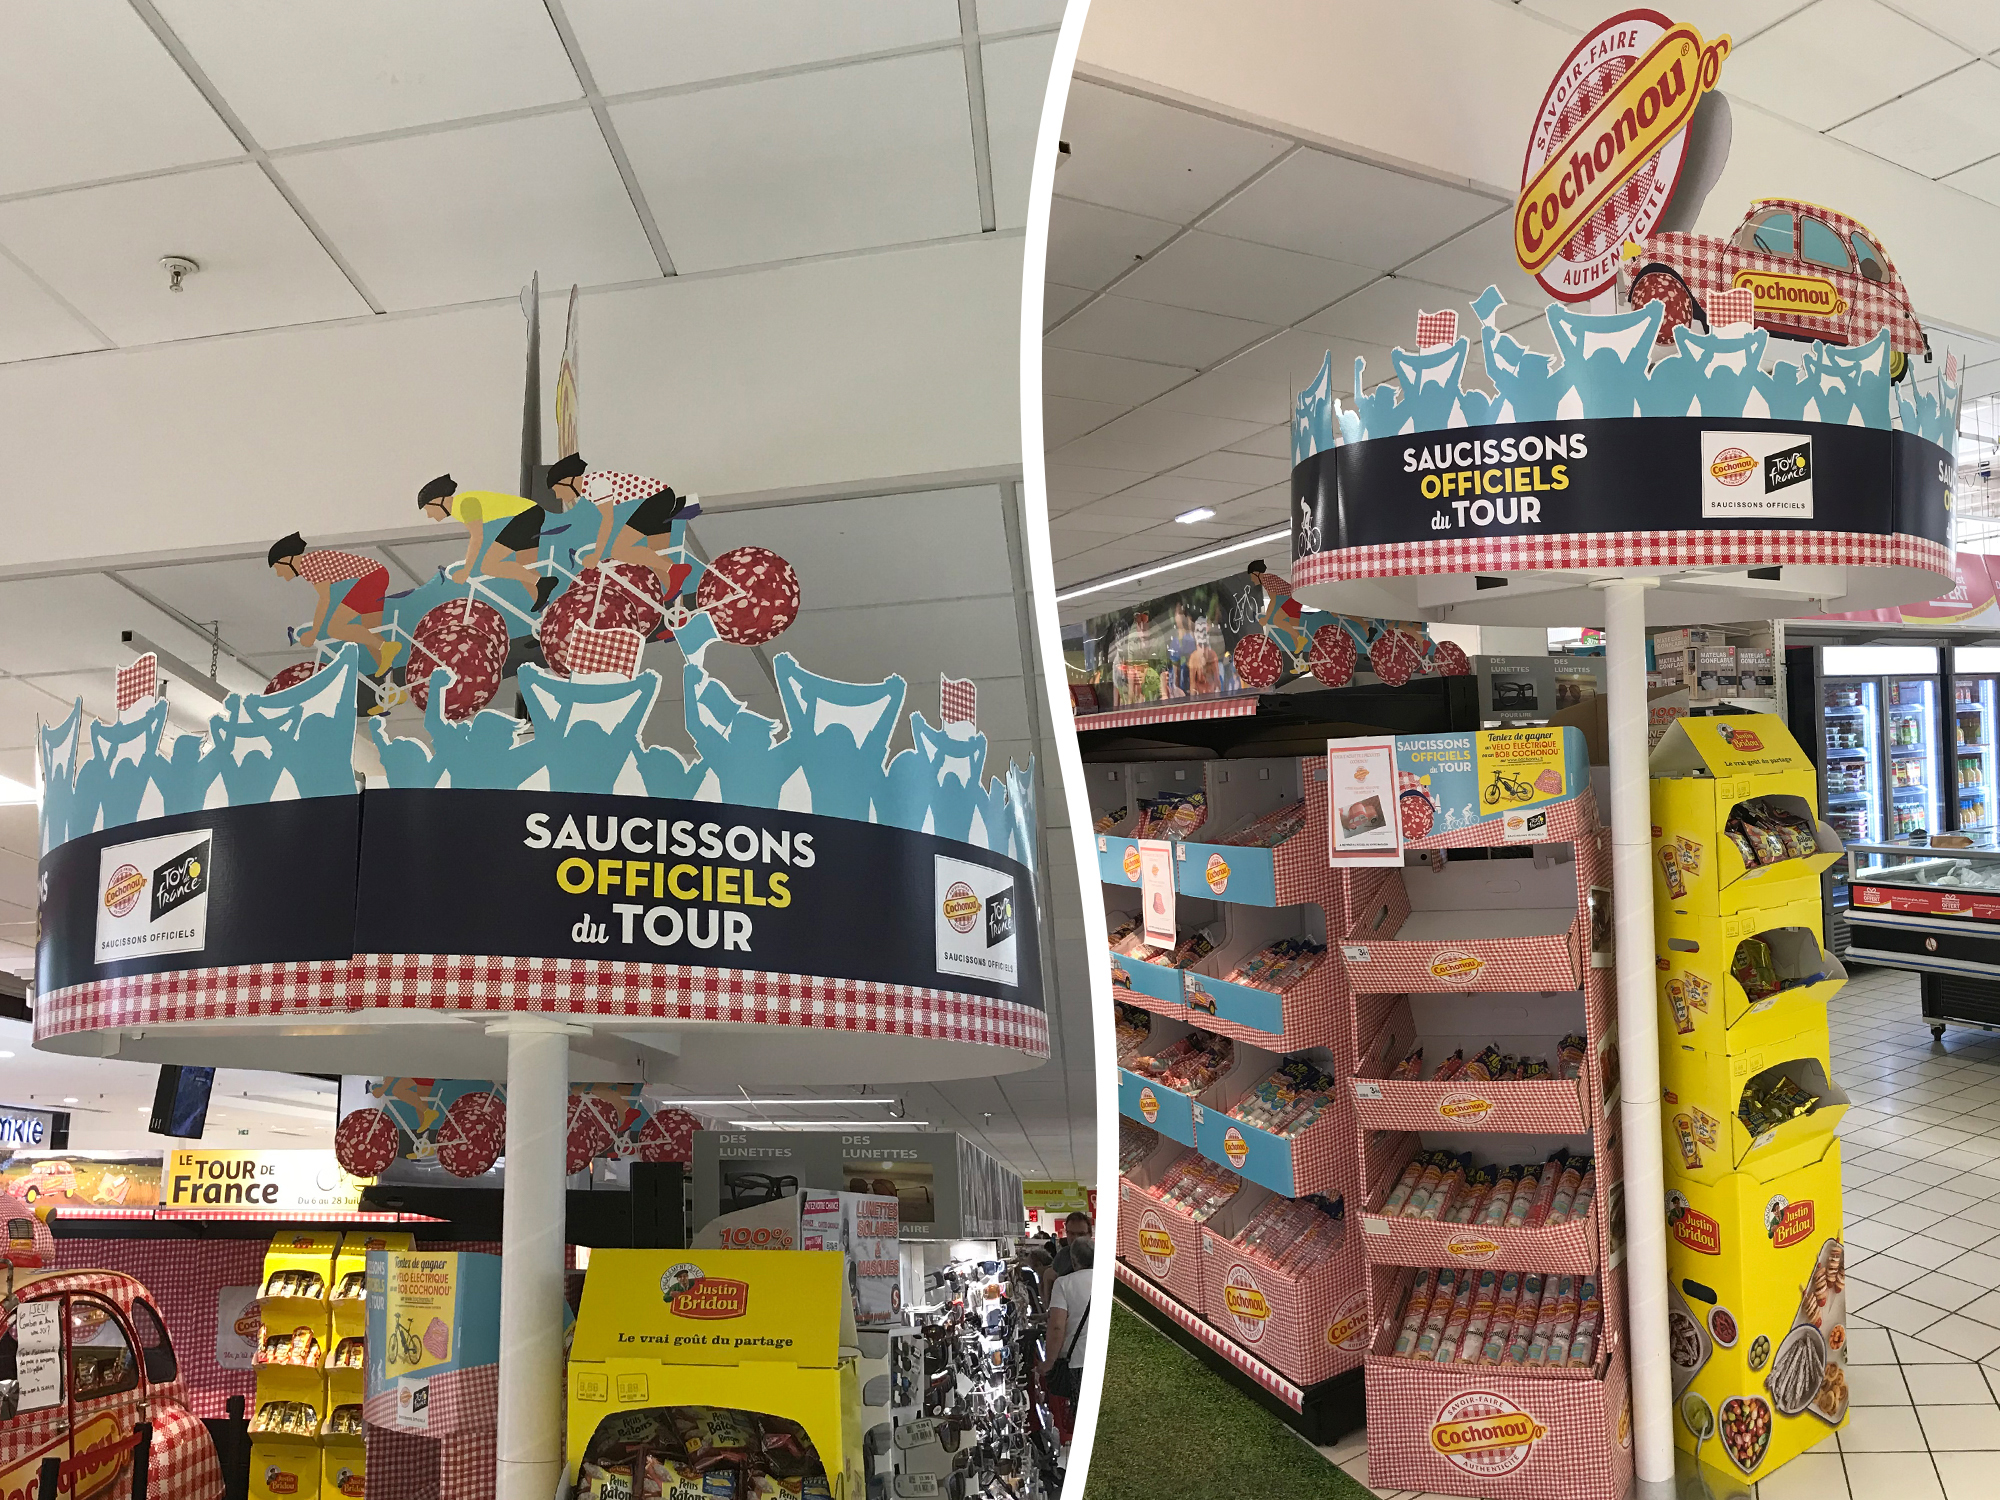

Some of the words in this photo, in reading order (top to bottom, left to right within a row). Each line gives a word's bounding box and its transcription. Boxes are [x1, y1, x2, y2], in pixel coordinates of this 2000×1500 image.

[1537, 30, 1639, 151] SAVOIR-FAIRE
[1522, 58, 1687, 254] Cochonou
[1403, 433, 1588, 472] SAUCISSONS
[1713, 460, 1751, 474] Cochonou
[1421, 465, 1570, 499] OFFICIELS
[1431, 510, 1452, 530] du
[1452, 496, 1542, 528] TOUR
[1651, 707, 1688, 718] 100%
[1397, 739, 1470, 751] SAUCISSONS
[1488, 733, 1512, 741] Tentez
[1514, 732, 1523, 740] de
[1525, 732, 1553, 742] gagner
[1732, 739, 1759, 748] Bridou
[1411, 750, 1471, 762] OFFICIELS
[1438, 762, 1471, 772] TOUR
[523, 812, 817, 868] SAUCISSONS
[106, 878, 141, 903] Cochonou
[556, 857, 792, 908] OFFICIELS
[945, 899, 977, 914] Cochonou
[571, 913, 609, 944] du
[612, 903, 753, 952] TOUR
[101, 935, 147, 950] SAUCISSONS
[150, 929, 195, 943] OFFICIELS
[944, 952, 986, 967] SAUCISSONS
[988, 960, 1014, 973] OFFICIELS
[1433, 960, 1476, 974] Cochonou
[1443, 1101, 1486, 1115] Cochonou
[719, 1134, 747, 1144] DES
[842, 1136, 871, 1145] DES
[719, 1148, 792, 1157] LUNETTES
[842, 1149, 918, 1159] LUNETTES
[179, 1155, 193, 1166] LE
[195, 1160, 256, 1179] TOUR
[260, 1165, 275, 1175] DE
[173, 1175, 279, 1204] France
[297, 1197, 309, 1205] Du
[332, 1197, 343, 1205] 28
[856, 1200, 898, 1219] LUNETTES
[1686, 1214, 1712, 1232] Justin
[1785, 1206, 1808, 1223] Justin
[721, 1227, 793, 1245] 100%
[857, 1220, 898, 1238] SOLAIRES
[1676, 1222, 1715, 1248] Bridou
[1777, 1219, 1810, 1243] Bridou
[1140, 1234, 1170, 1250] Cochonou
[1449, 1243, 1494, 1254] Cochonou
[421, 1260, 447, 1272] gagner
[857, 1260, 899, 1277] MASQUES
[694, 1283, 737, 1296] Justin
[678, 1294, 738, 1311] Bridou
[1227, 1291, 1264, 1312] Cochonou
[618, 1333, 635, 1343] Le
[640, 1333, 670, 1344] vrai
[674, 1334, 707, 1347] goût
[712, 1335, 731, 1345] du
[734, 1337, 793, 1349] partage
[1448, 1396, 1504, 1416] SAVOIR-FAIRE
[1437, 1421, 1527, 1447] Cochonou
[272, 1481, 295, 1490] Bridou
[610, 1474, 629, 1488] Petits
[679, 1478, 698, 1490] Petits
